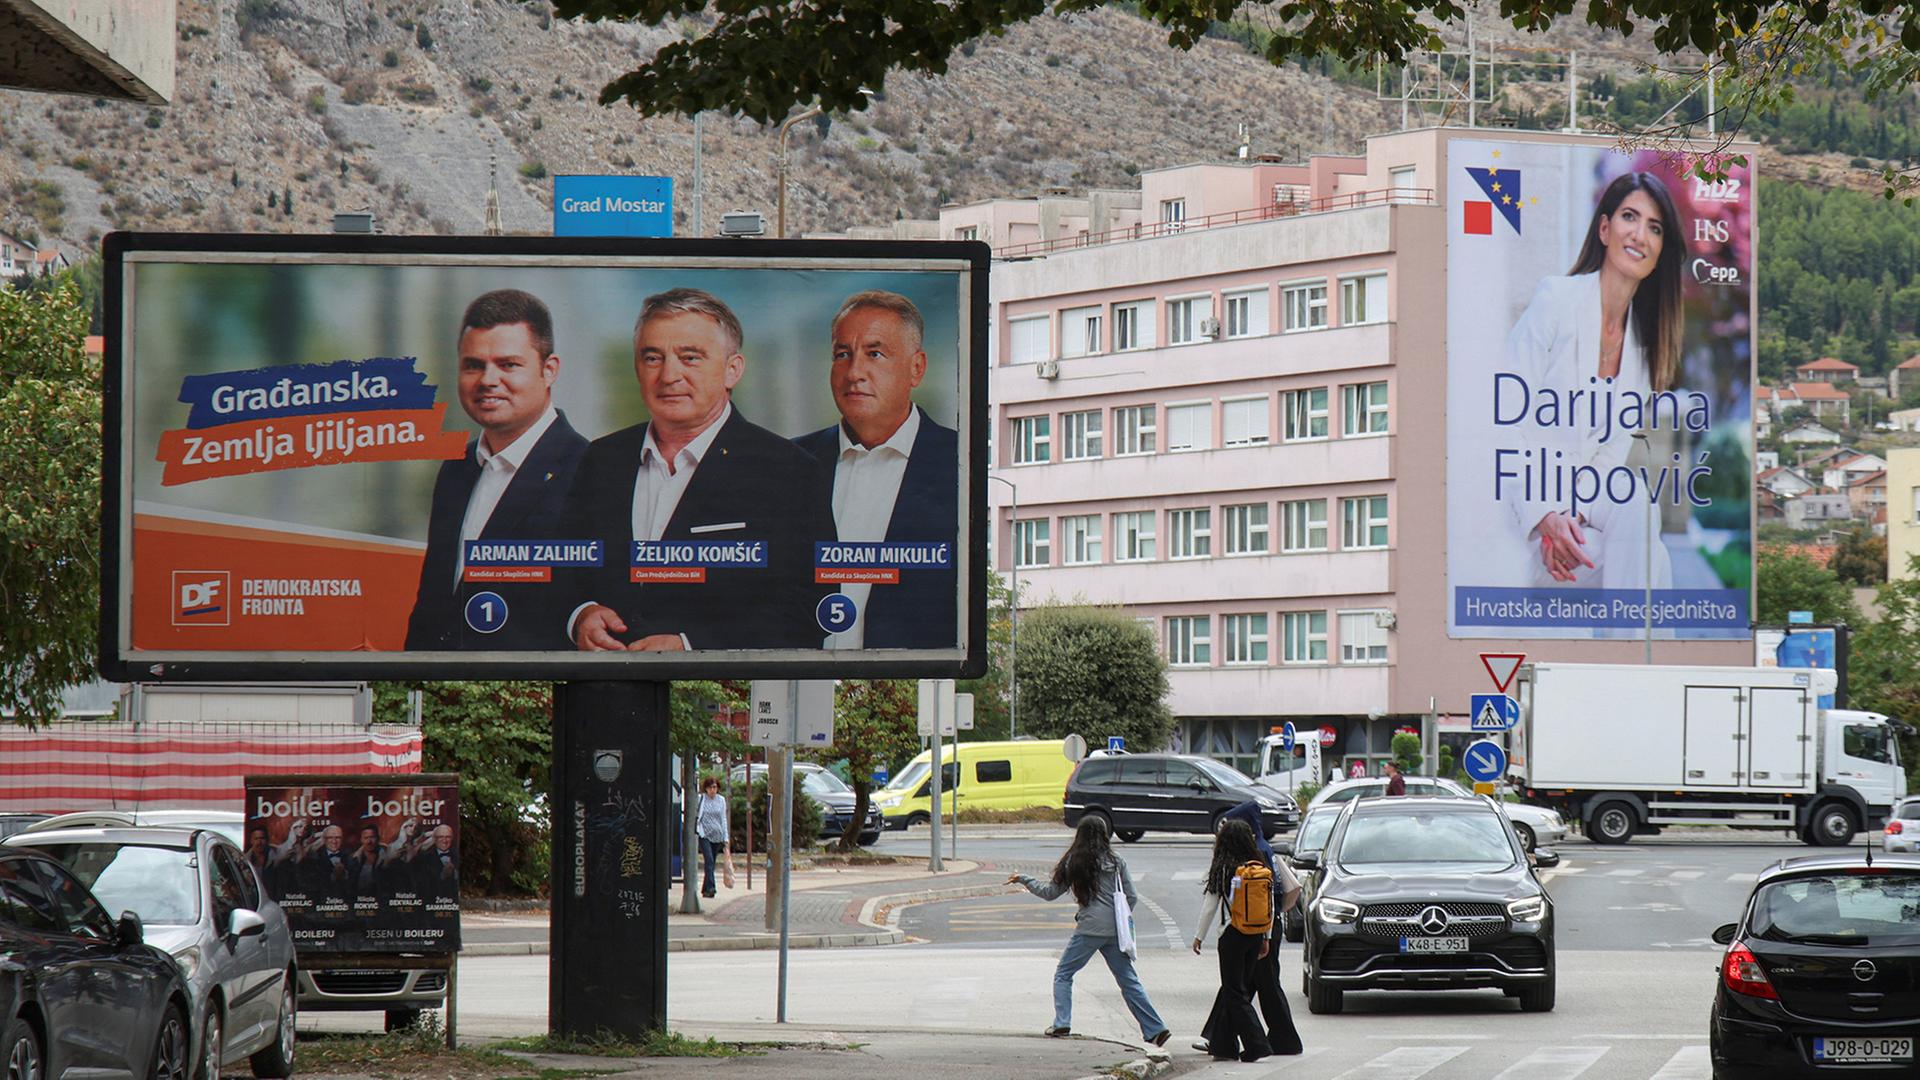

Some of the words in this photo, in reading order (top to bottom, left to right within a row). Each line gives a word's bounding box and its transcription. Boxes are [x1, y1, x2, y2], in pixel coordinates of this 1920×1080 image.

[562, 197, 601, 213] Grad
[605, 197, 665, 213] Mostar
[1694, 219, 1729, 243] HNS
[1710, 266, 1738, 282] epp
[211, 371, 398, 414] Građanska.
[1494, 373, 1710, 444] Darijana
[182, 426, 295, 465] Zemlja
[305, 418, 425, 459] ljiljana.
[1495, 448, 1712, 517] Filipović
[469, 545, 529, 561] ARMAN
[533, 541, 598, 561] ZALIHIĆ
[636, 542, 694, 564] ŽELJKO
[698, 542, 761, 562] KOMŠIĆ
[821, 547, 875, 563] ZORAN
[880, 543, 947, 564] MIKULIĆ
[182, 580, 221, 608] DF
[242, 579, 362, 596] DEMOKRATSKA
[242, 598, 304, 615] FRONTA
[480, 601, 493, 622] 1
[830, 603, 845, 624] 5
[1466, 598, 1543, 618] Hrvatska
[1547, 598, 1608, 619] članica
[257, 796, 335, 817] boiler
[367, 796, 445, 817] boiler
[295, 930, 335, 938] BOILERU
[366, 930, 393, 938] JESEN
[395, 930, 402, 938] U
[404, 930, 444, 938] BOILERU
[1408, 938, 1466, 950] K48-E-951
